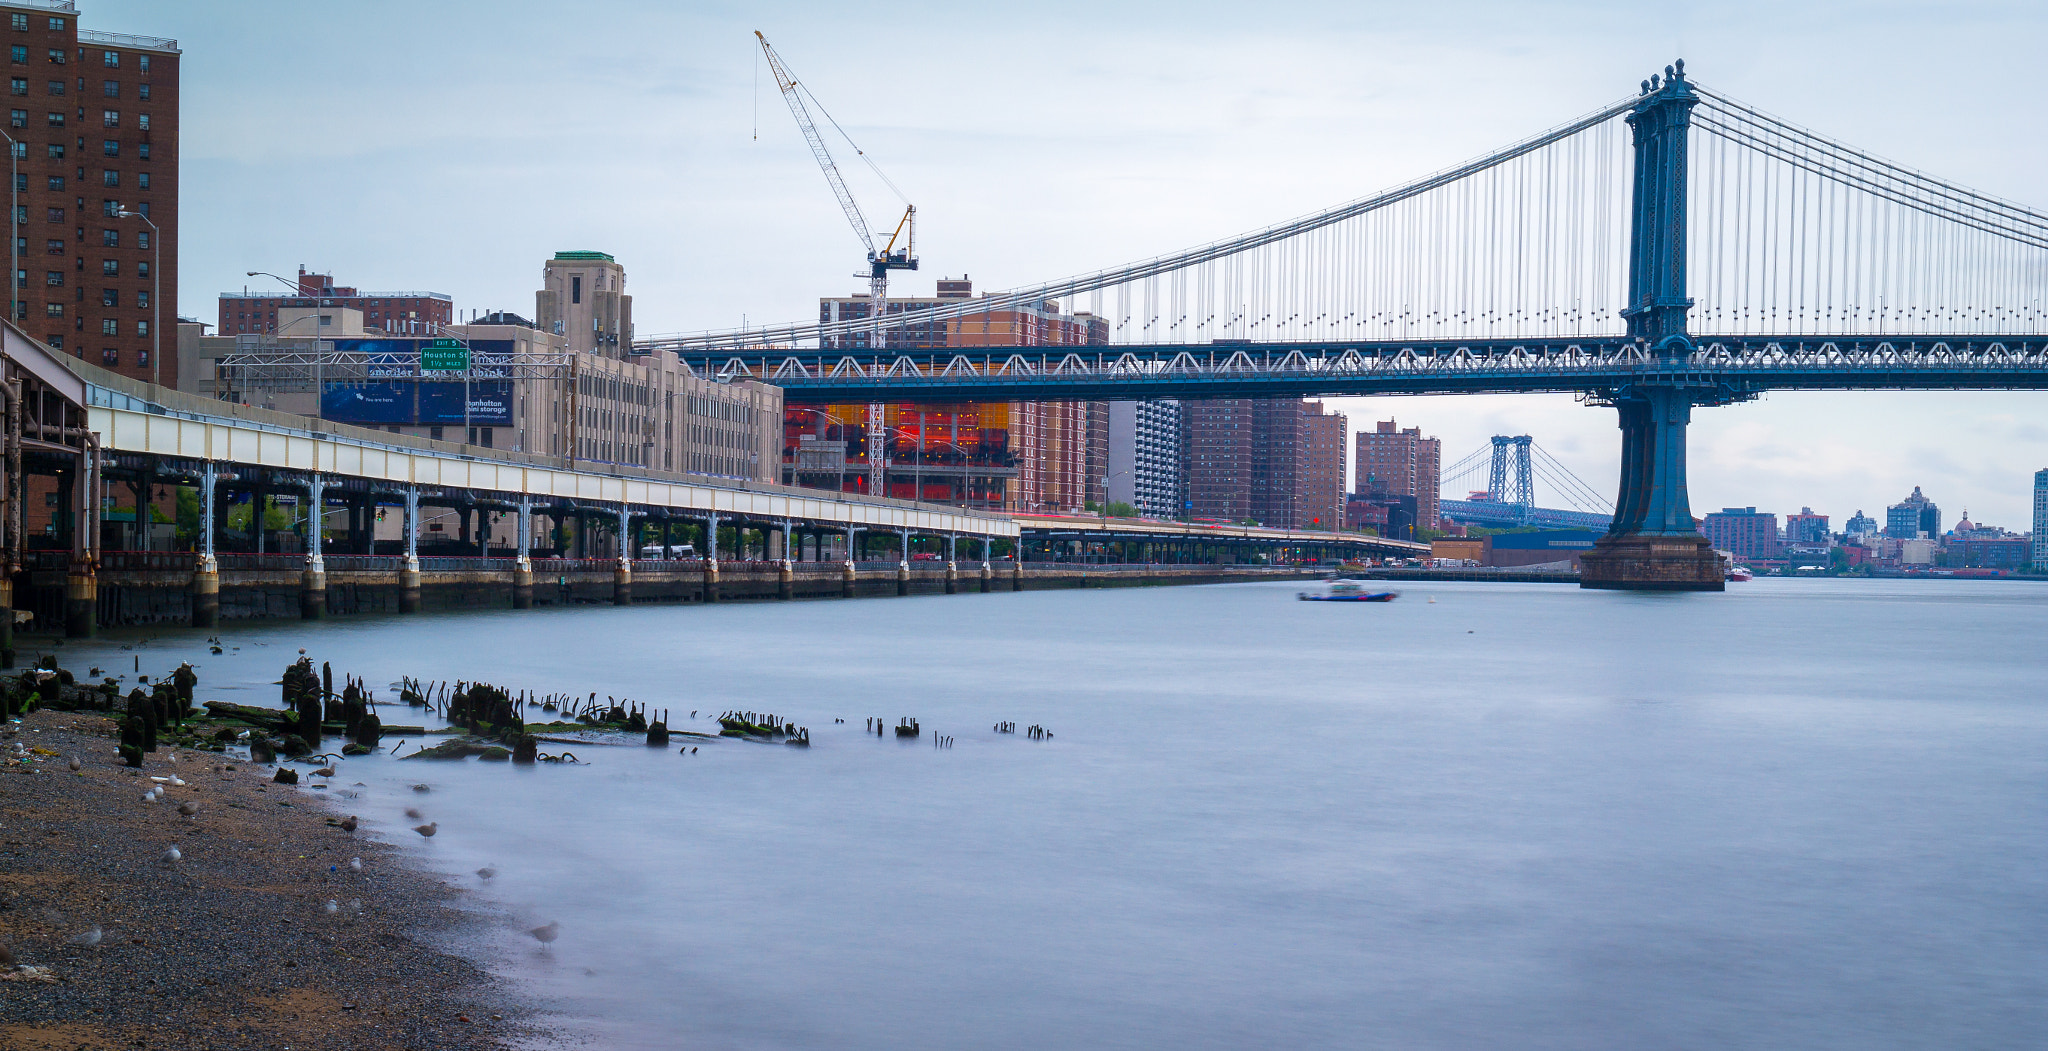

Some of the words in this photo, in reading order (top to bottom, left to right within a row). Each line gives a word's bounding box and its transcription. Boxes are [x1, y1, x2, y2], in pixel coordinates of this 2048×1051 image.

[451, 339, 457, 347] 5
[424, 351, 456, 359] Houston
[458, 351, 468, 359] St
